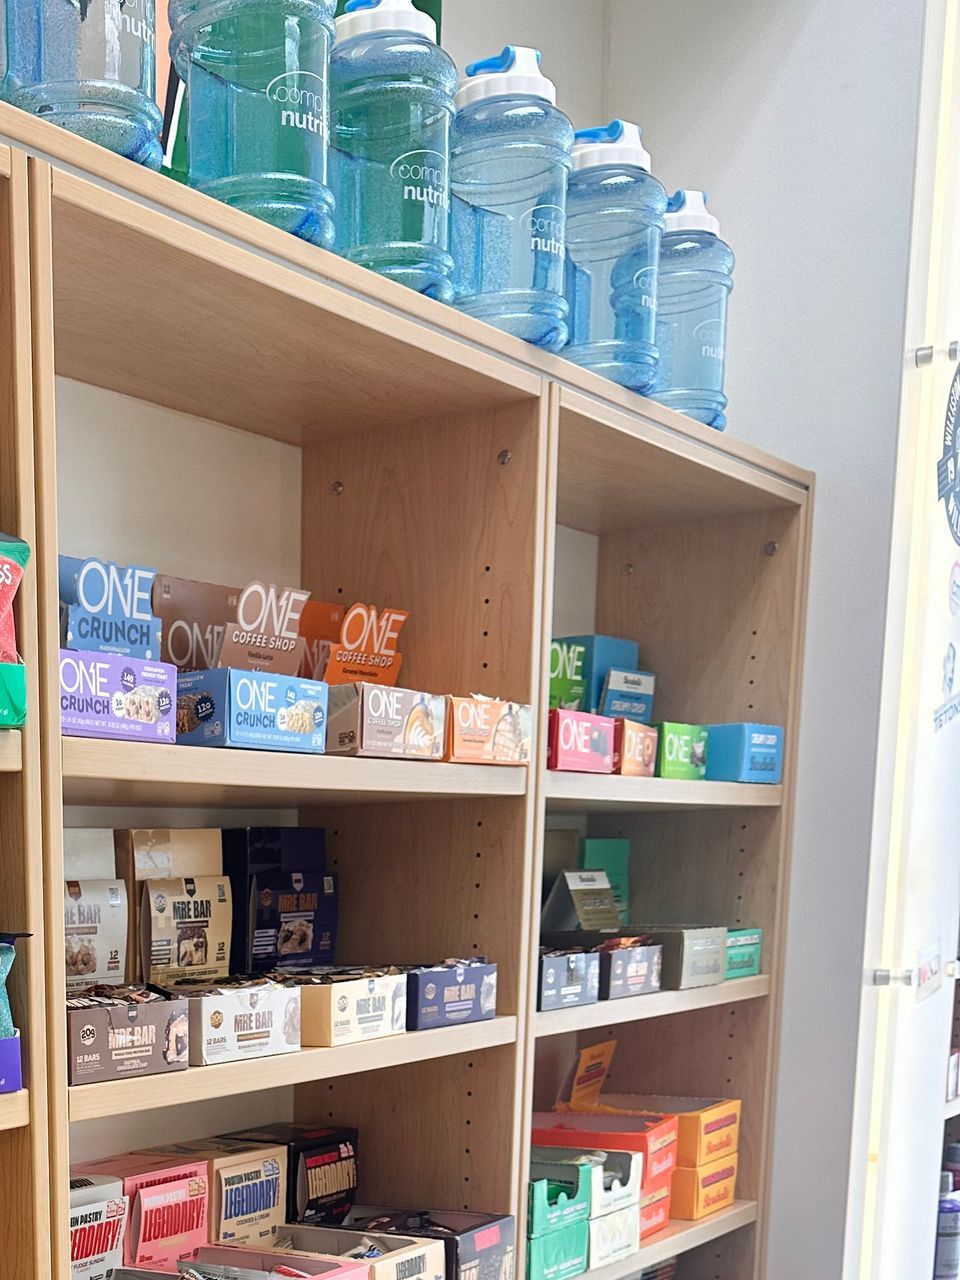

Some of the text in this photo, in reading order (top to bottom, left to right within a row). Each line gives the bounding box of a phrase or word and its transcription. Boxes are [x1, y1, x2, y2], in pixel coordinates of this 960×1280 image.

[79, 561, 154, 621] ONE
[238, 584, 311, 639] ONE
[78, 616, 150, 646] CRUNCH
[232, 630, 296, 651] COFFEE SHOP
[342, 607, 409, 654] ONE
[336, 650, 393, 668] COFFEE SHOP
[59, 657, 112, 698] ONE
[60, 694, 110, 715] CRUNCH
[236, 678, 279, 713] ONE
[369, 688, 402, 721] ONE
[235, 712, 275, 728] CRUNCH
[457, 702, 491, 729] ONE
[560, 718, 592, 753] ONE
[665, 733, 690, 762] ONE
[173, 900, 212, 920] MRE BAR
[278, 893, 318, 912] MRE BAR
[109, 950, 118, 960] 12
[218, 942, 226, 951] 12
[234, 1010, 273, 1032] MRE BAR
[76, 1053, 100, 1063] 12 BARS
[308, 1158, 354, 1200] LEGENDARY
[224, 1178, 277, 1220] LEGENDARY
[142, 1199, 204, 1244] LEGENDARY
